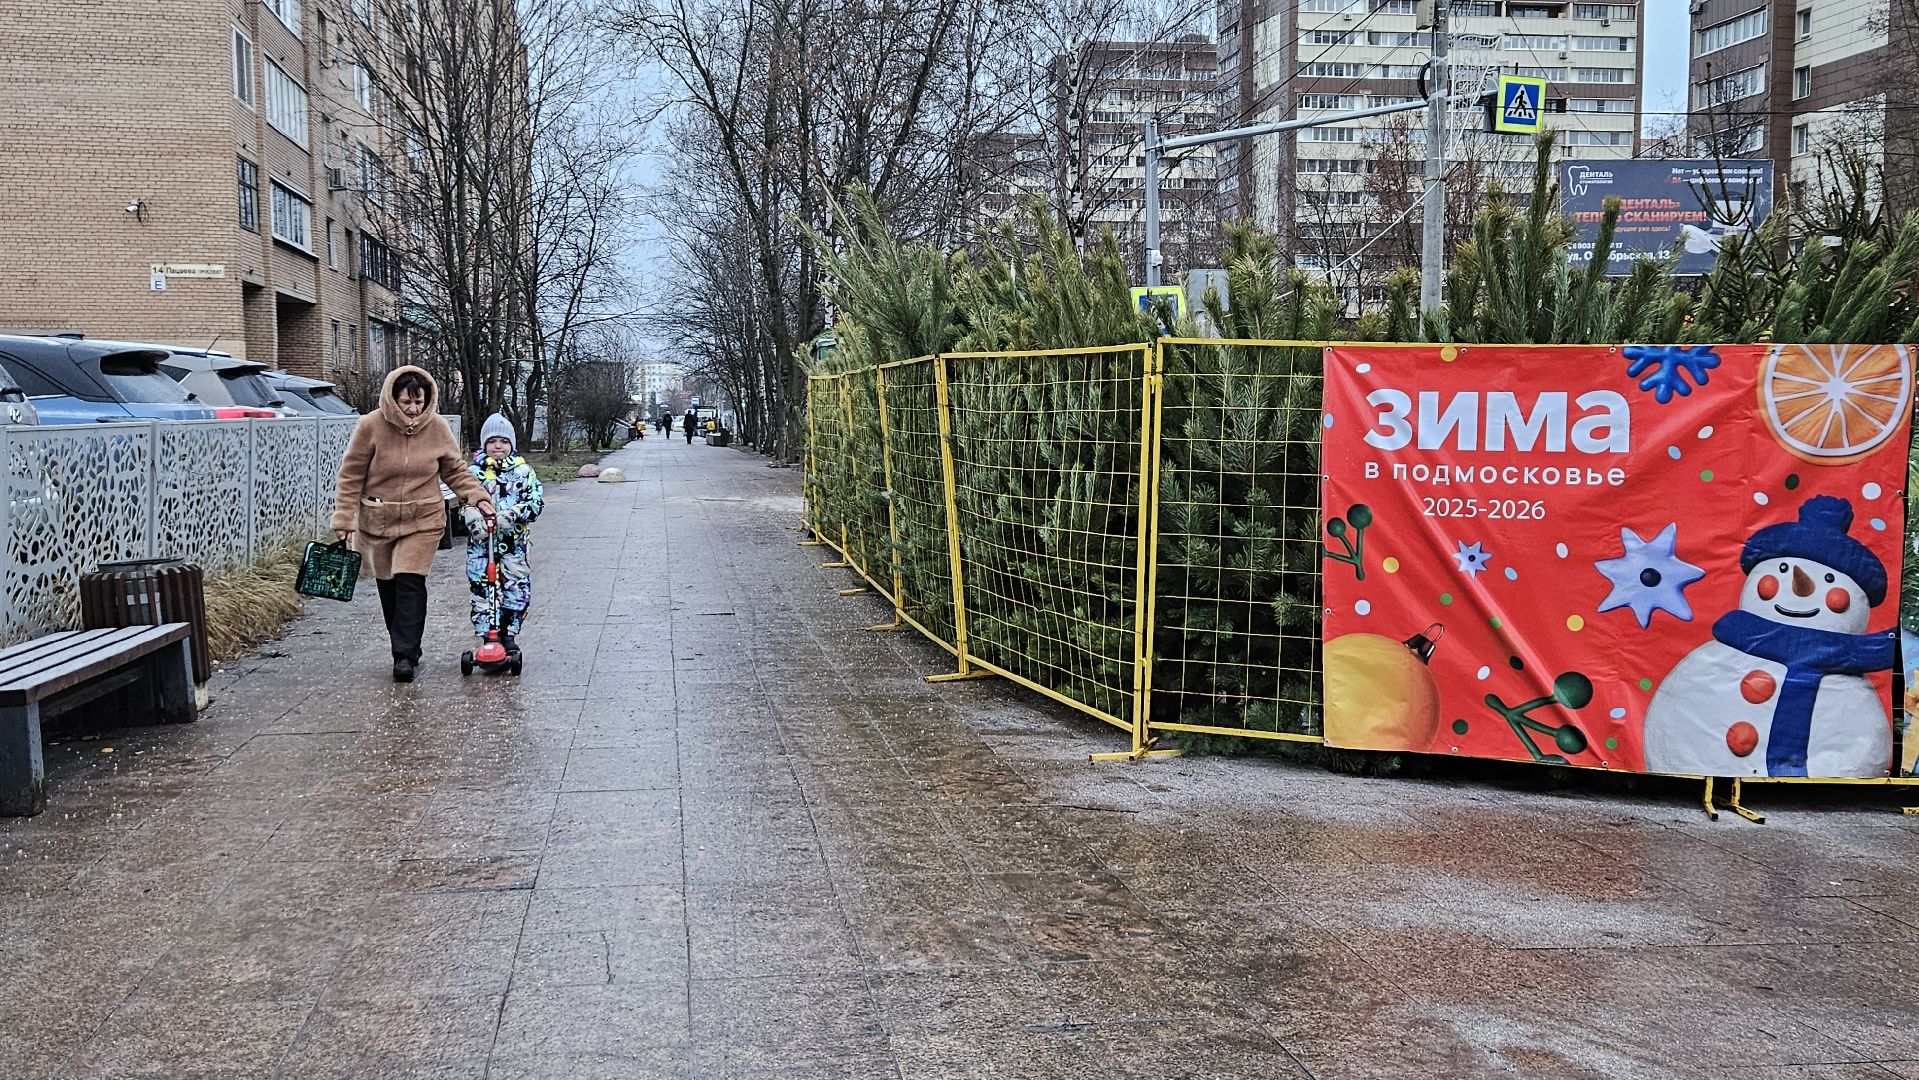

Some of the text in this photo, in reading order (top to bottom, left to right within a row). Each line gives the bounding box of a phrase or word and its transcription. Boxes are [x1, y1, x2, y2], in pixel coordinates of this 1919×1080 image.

[1579, 171, 1613, 179] ДЕНТАЛЬ
[1624, 211, 1707, 222] СКАНИРУЕМ!
[1567, 252, 1583, 262] ул.
[1423, 497, 1546, 520] 2025-2026
